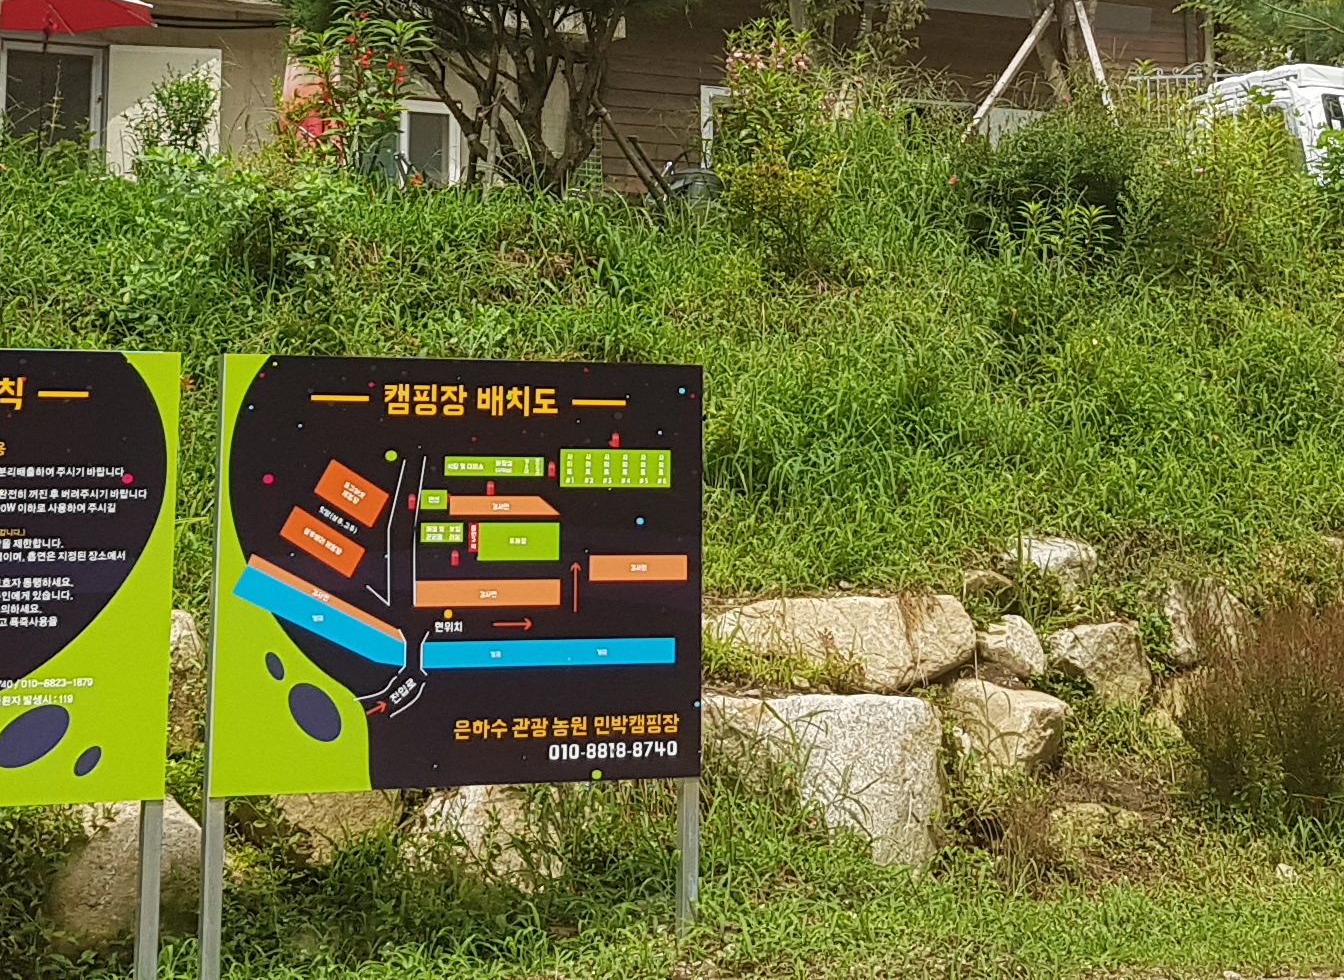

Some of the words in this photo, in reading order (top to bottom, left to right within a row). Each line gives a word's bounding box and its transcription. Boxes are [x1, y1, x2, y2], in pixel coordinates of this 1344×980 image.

[384, 383, 467, 416] 캠핑장
[477, 385, 558, 417] 배치도
[56, 467, 85, 477] 주시기
[434, 621, 463, 633] 현위치
[389, 677, 417, 704] 진입로
[454, 718, 508, 740] 은하수
[512, 717, 548, 738] 관광
[552, 715, 587, 737] 농원
[594, 713, 679, 736] 민박캠핑장
[548, 740, 678, 760] 010-8818-8740
